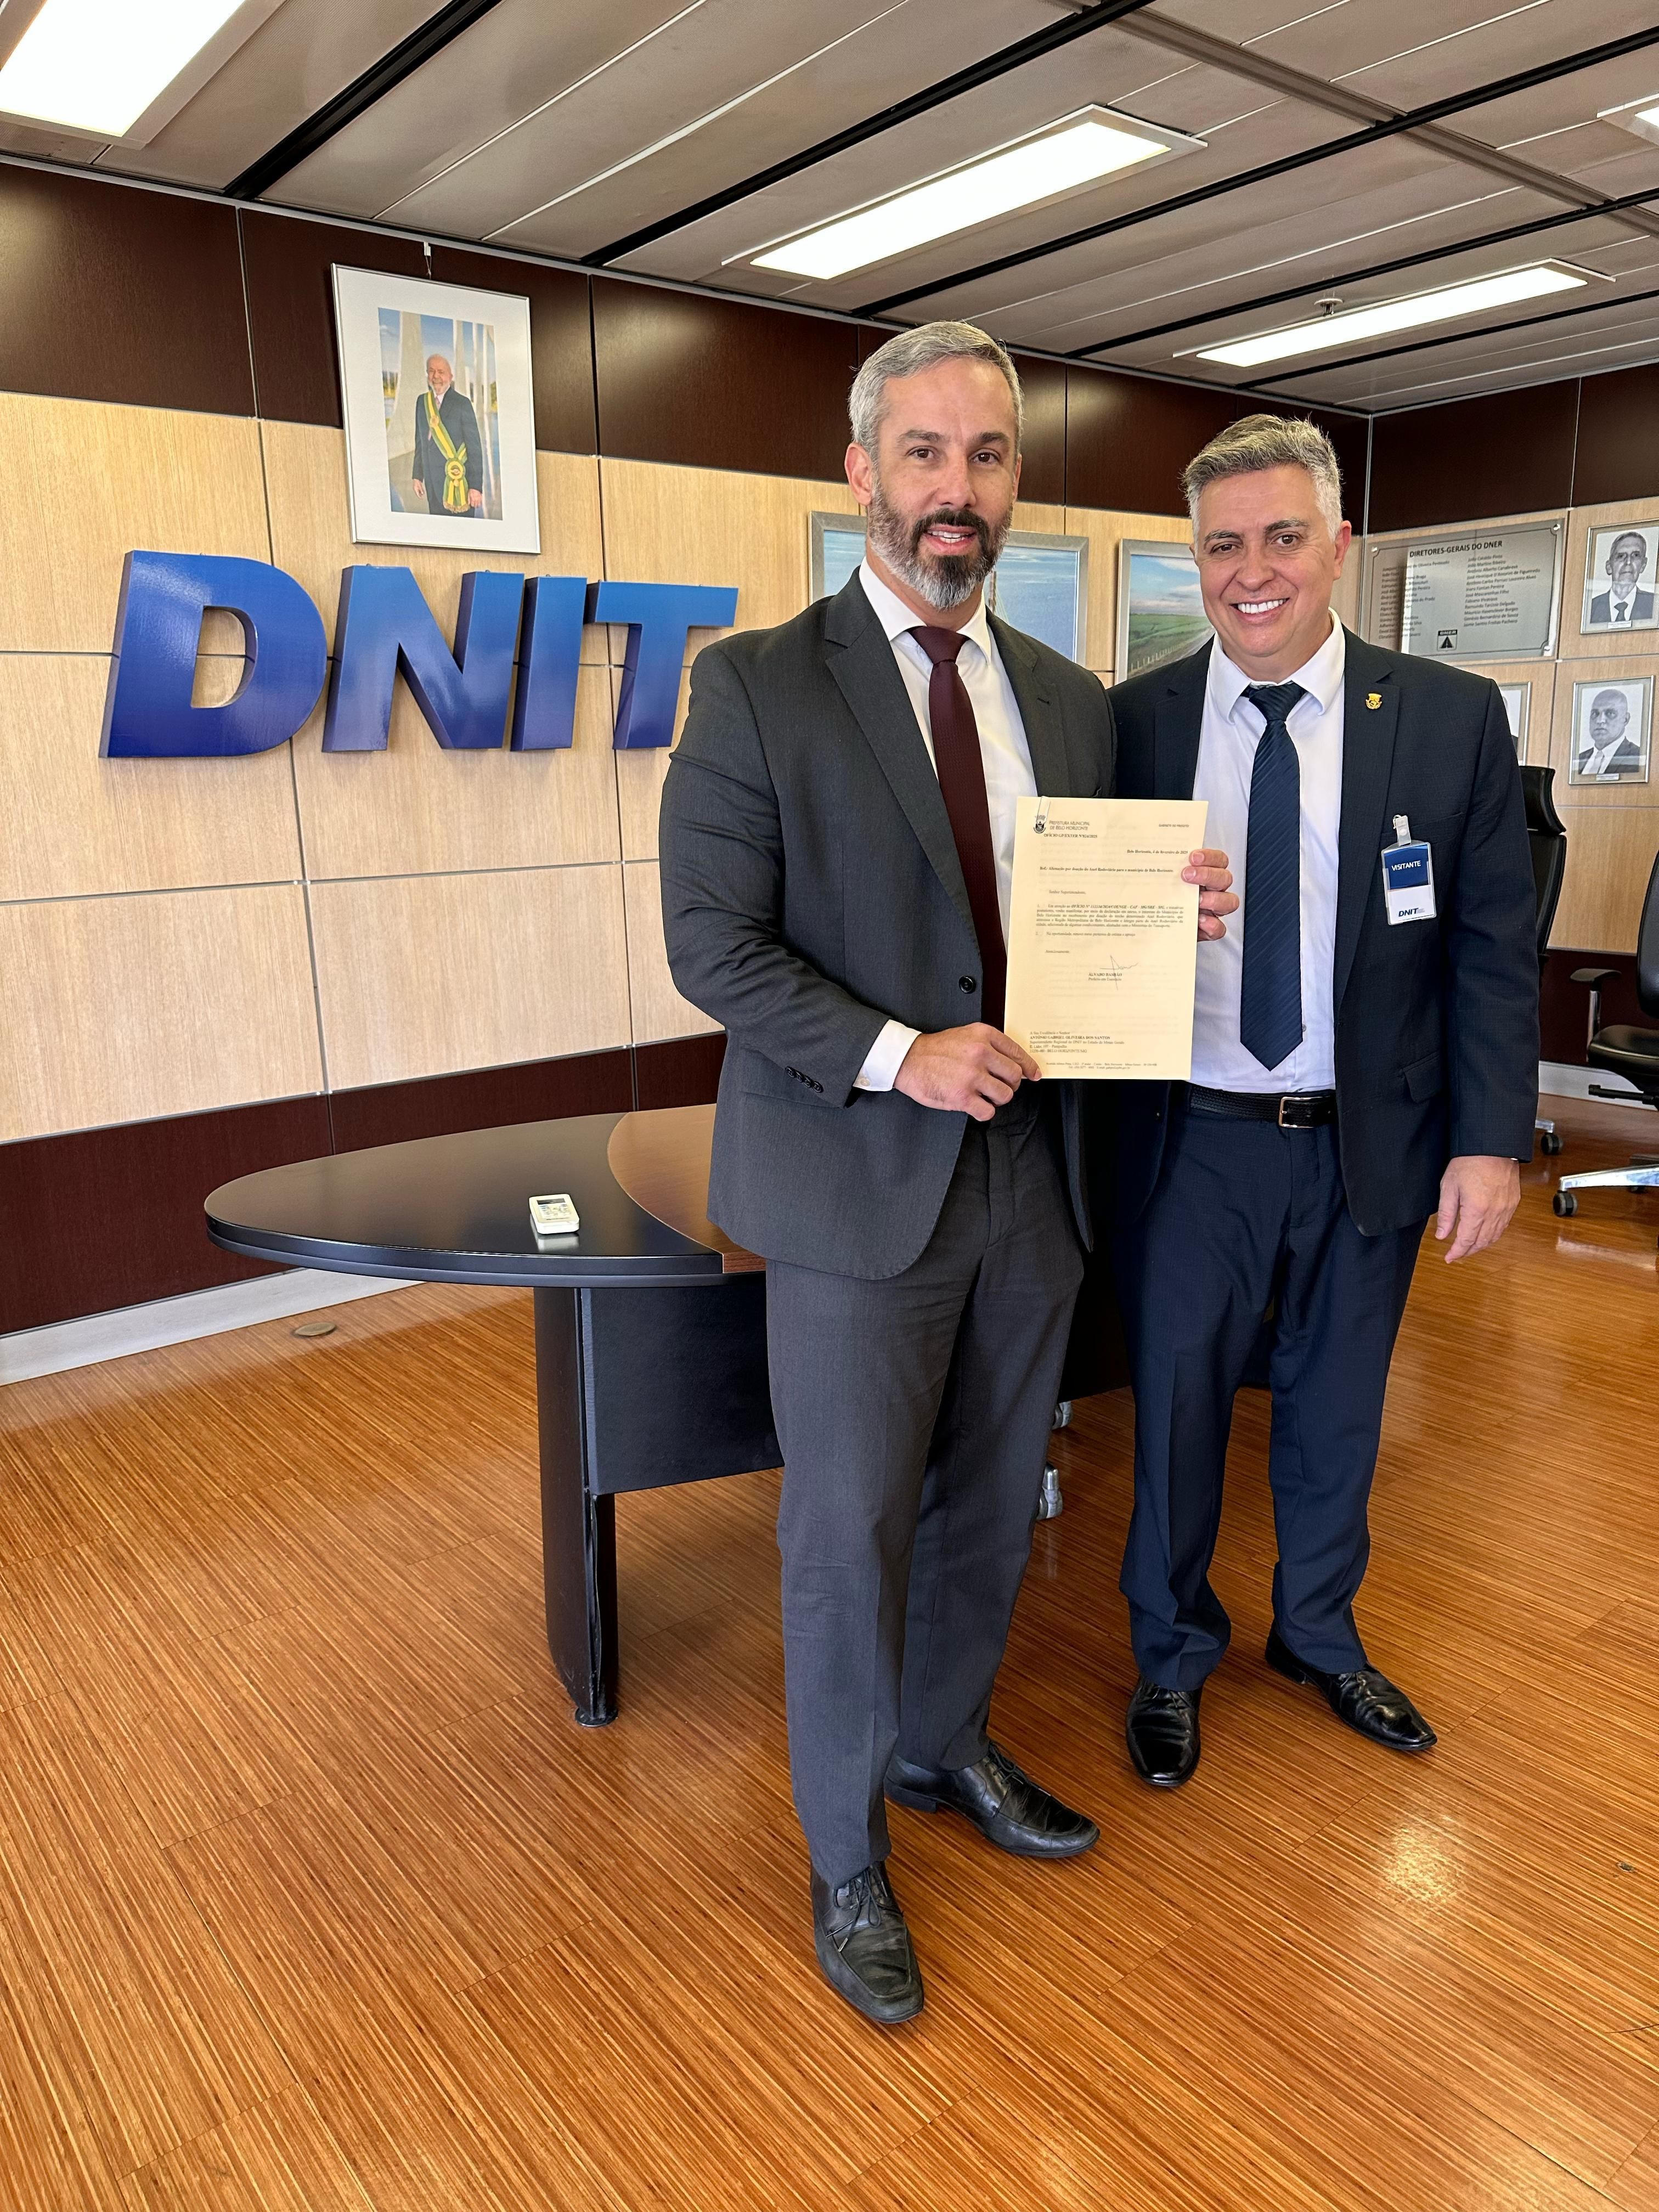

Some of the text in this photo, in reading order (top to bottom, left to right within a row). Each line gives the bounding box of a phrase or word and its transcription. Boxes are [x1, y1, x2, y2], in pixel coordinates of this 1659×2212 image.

[1409, 544, 1470, 558] DIRETORES-GERAIS
[1483, 540, 1502, 549] DNER
[98, 549, 739, 758] DNIT
[1391, 860, 1421, 871] VISITANTE
[1398, 907, 1419, 917] DNIT
